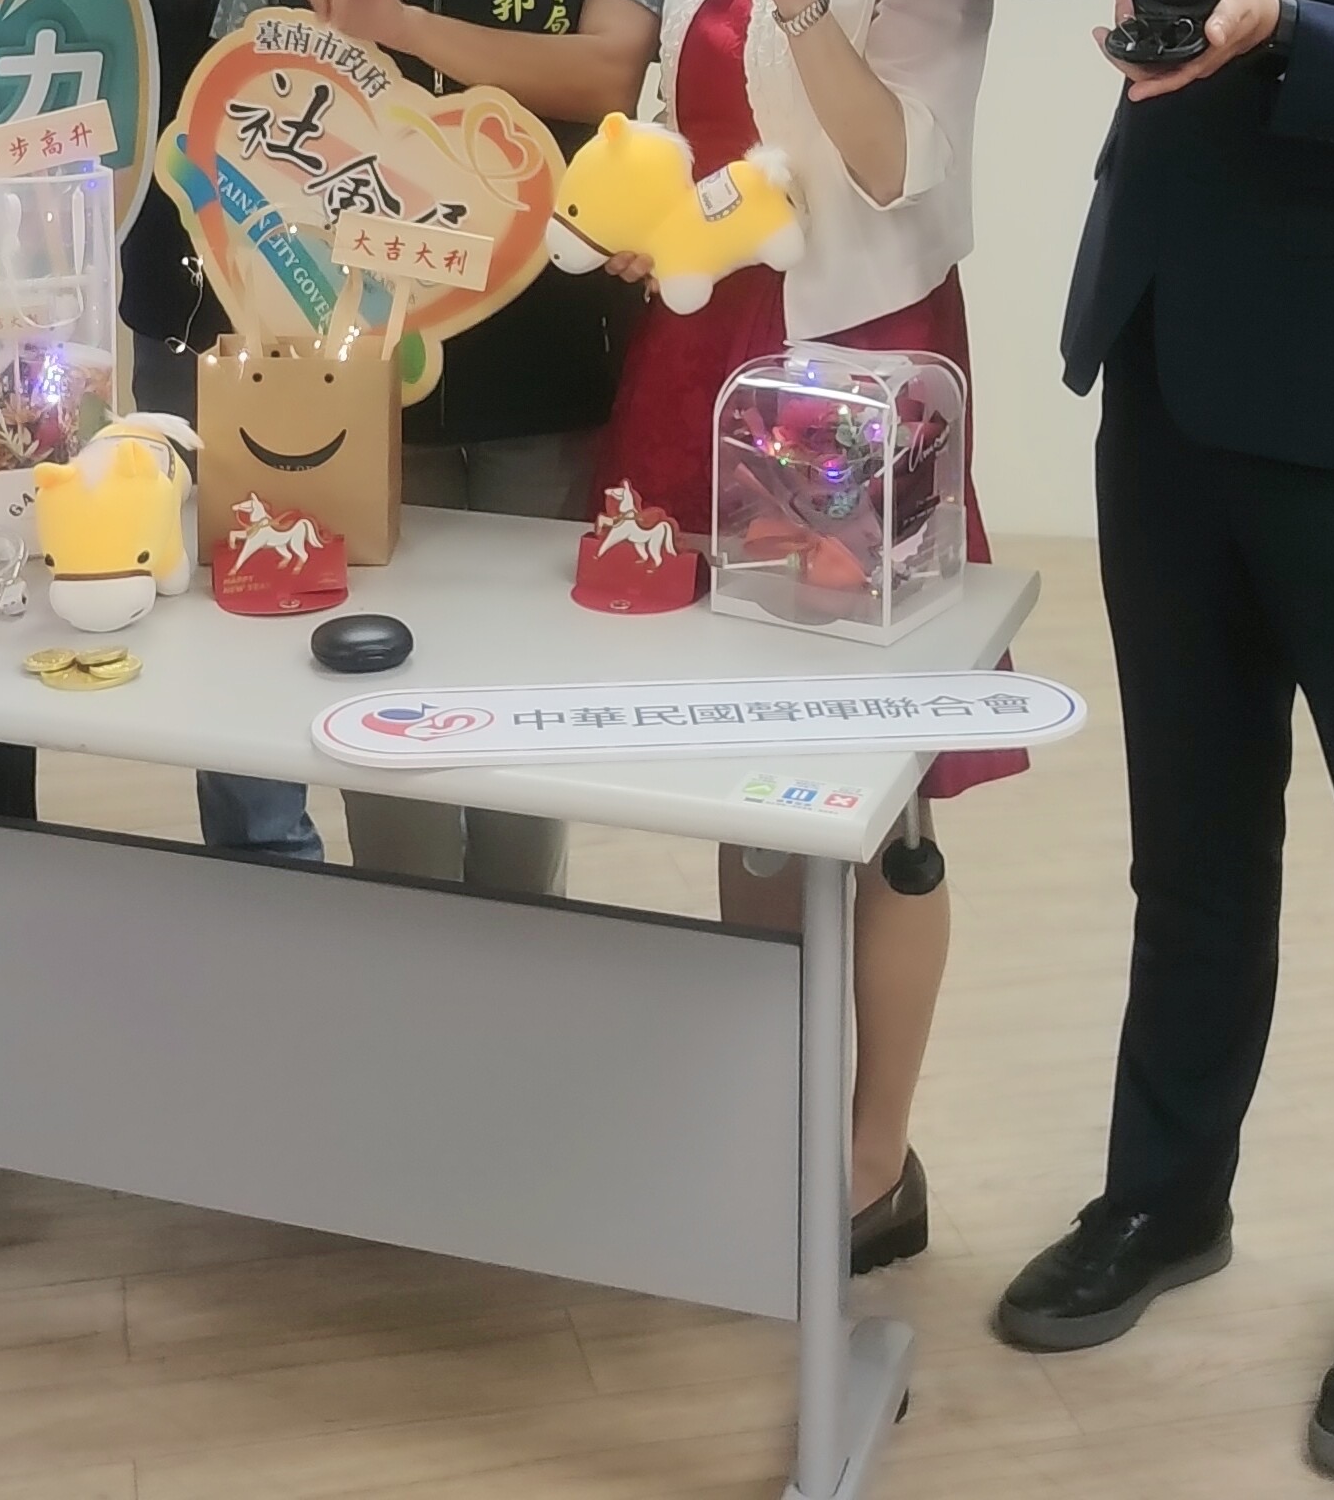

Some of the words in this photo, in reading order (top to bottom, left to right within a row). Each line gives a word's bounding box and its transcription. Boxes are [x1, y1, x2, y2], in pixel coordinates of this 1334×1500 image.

[255, 19, 391, 98] 臺南市政府
[228, 72, 468, 231] 社會
[353, 229, 468, 276] 大吉大利
[512, 692, 1031, 731] 中華民國聲暉聯合會
